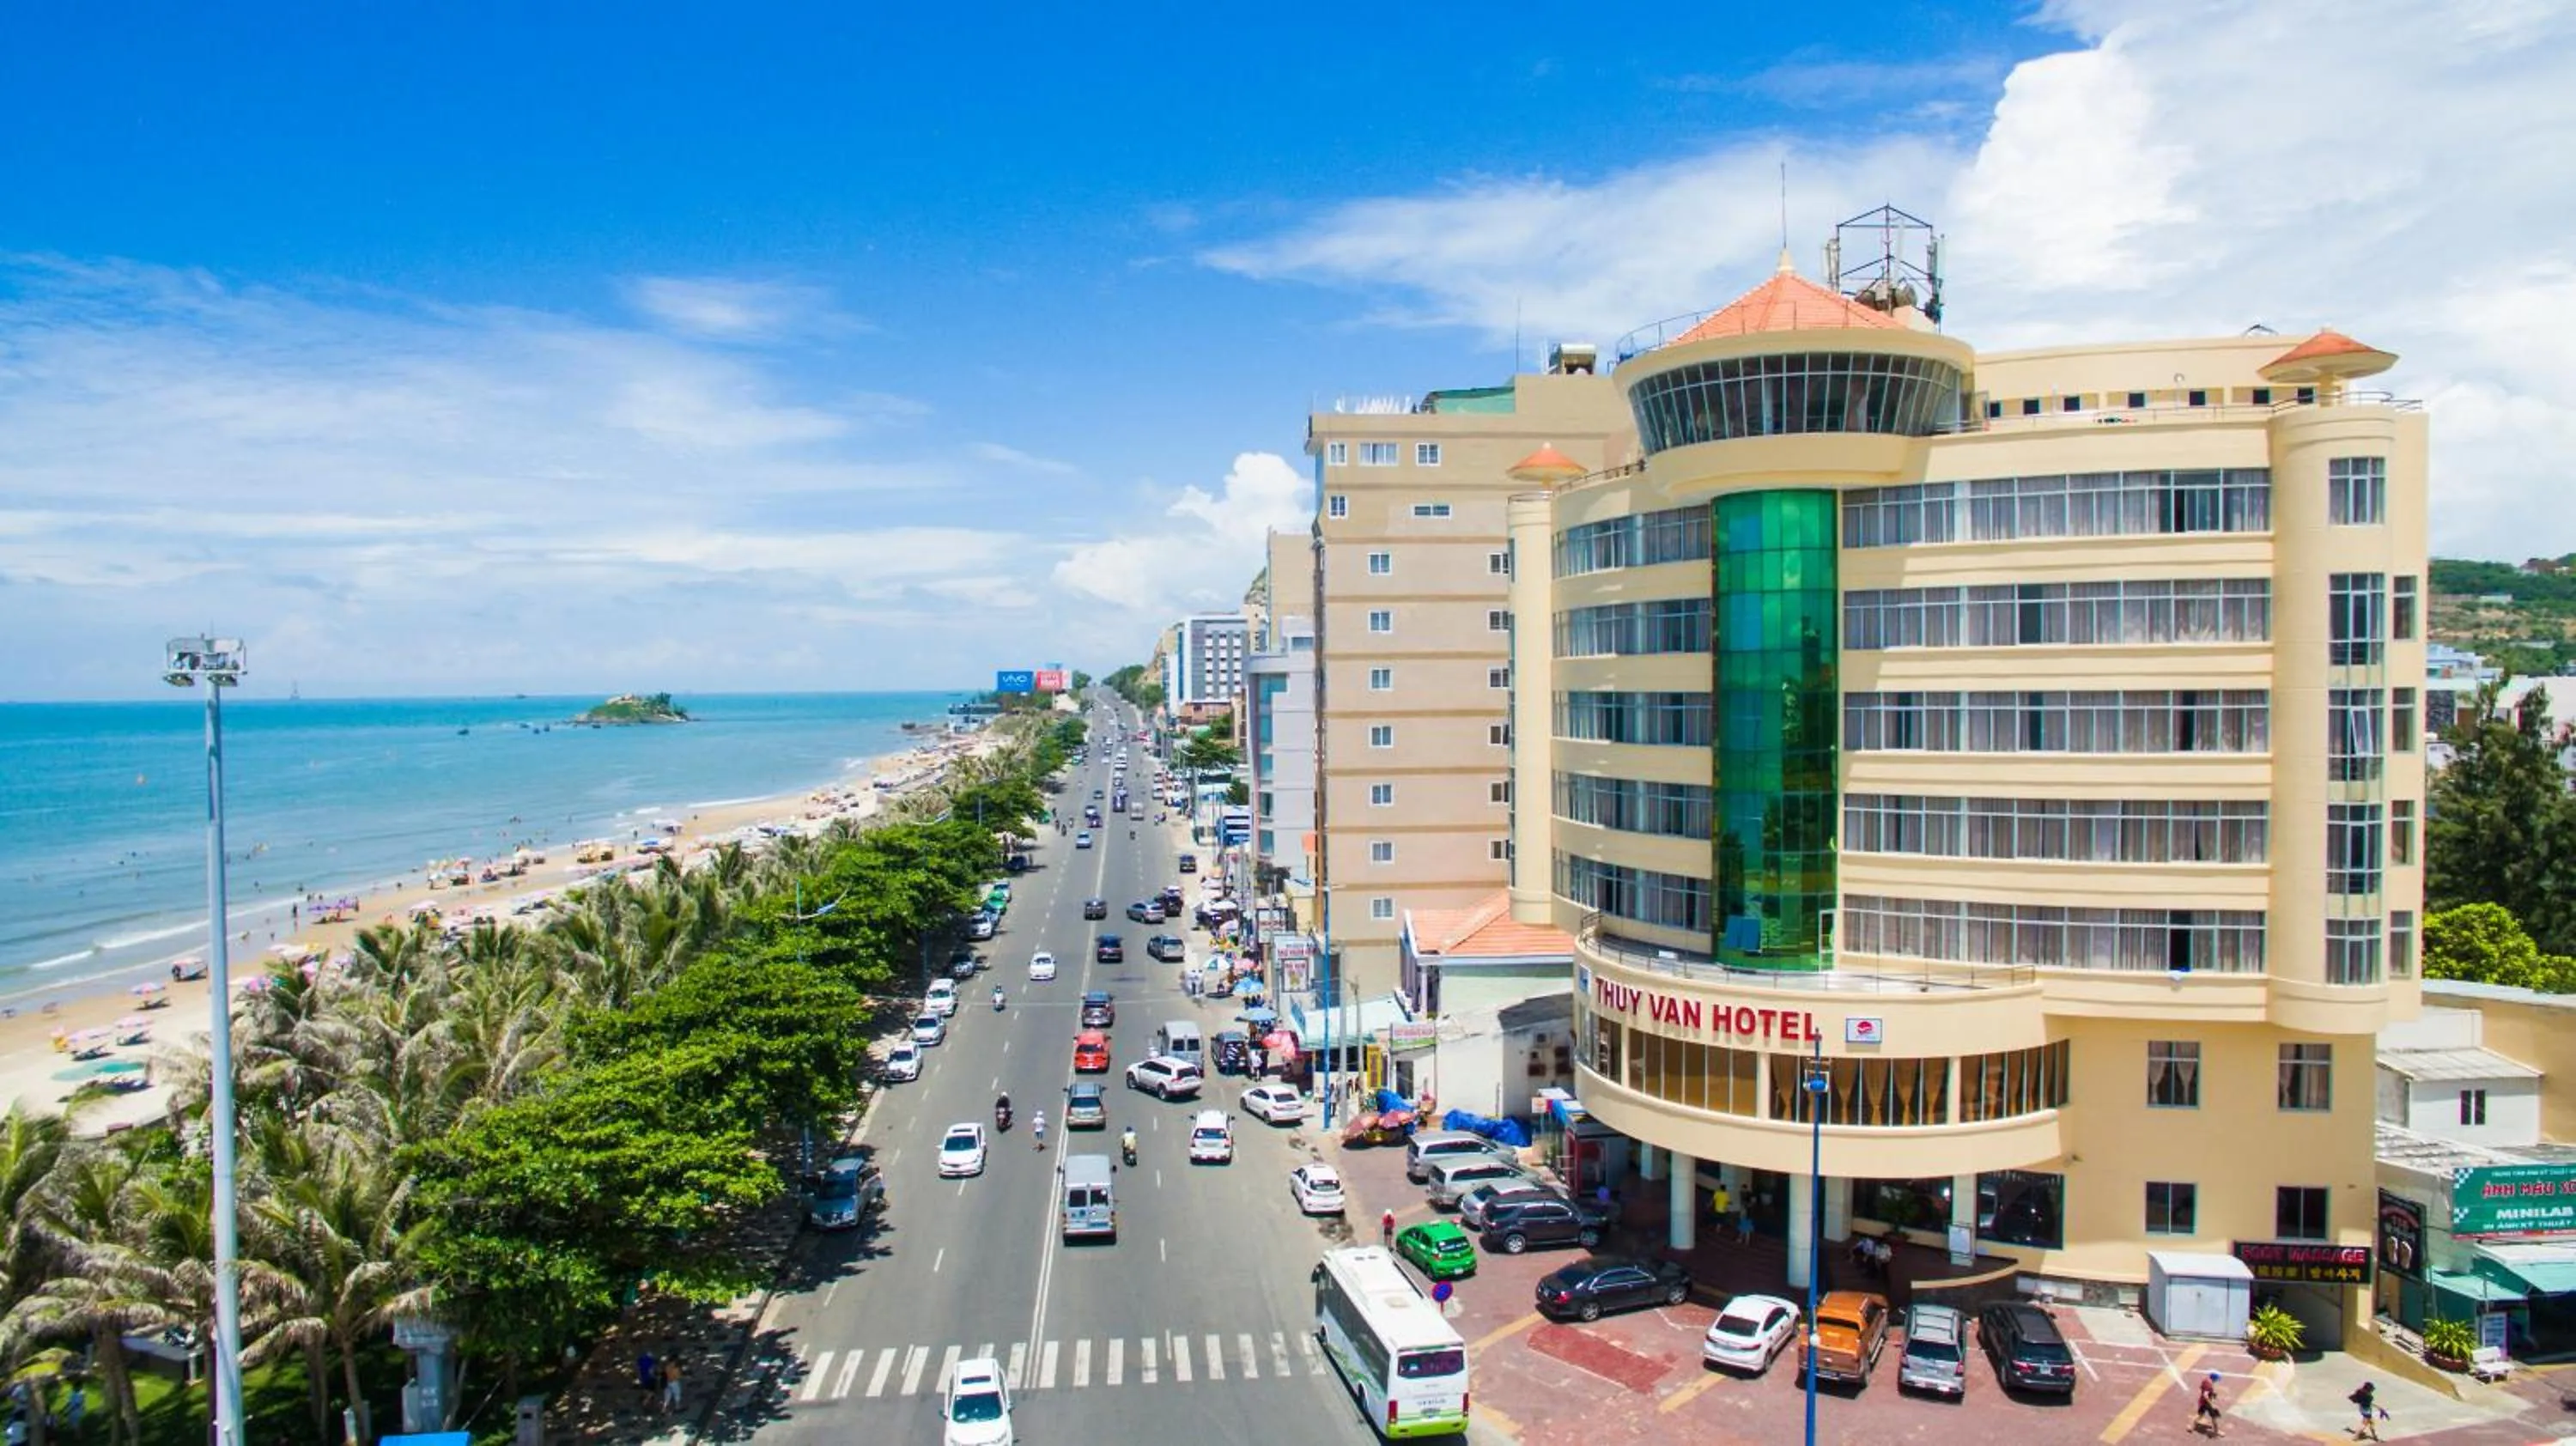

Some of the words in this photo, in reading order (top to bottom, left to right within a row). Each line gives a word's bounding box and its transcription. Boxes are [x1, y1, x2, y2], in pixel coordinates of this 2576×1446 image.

[1595, 977, 1642, 1016] THUY
[1649, 993, 1701, 1030] VAN
[1711, 1004, 1823, 1042] HOTEL
[2496, 1206, 2573, 1220] MINILAB
